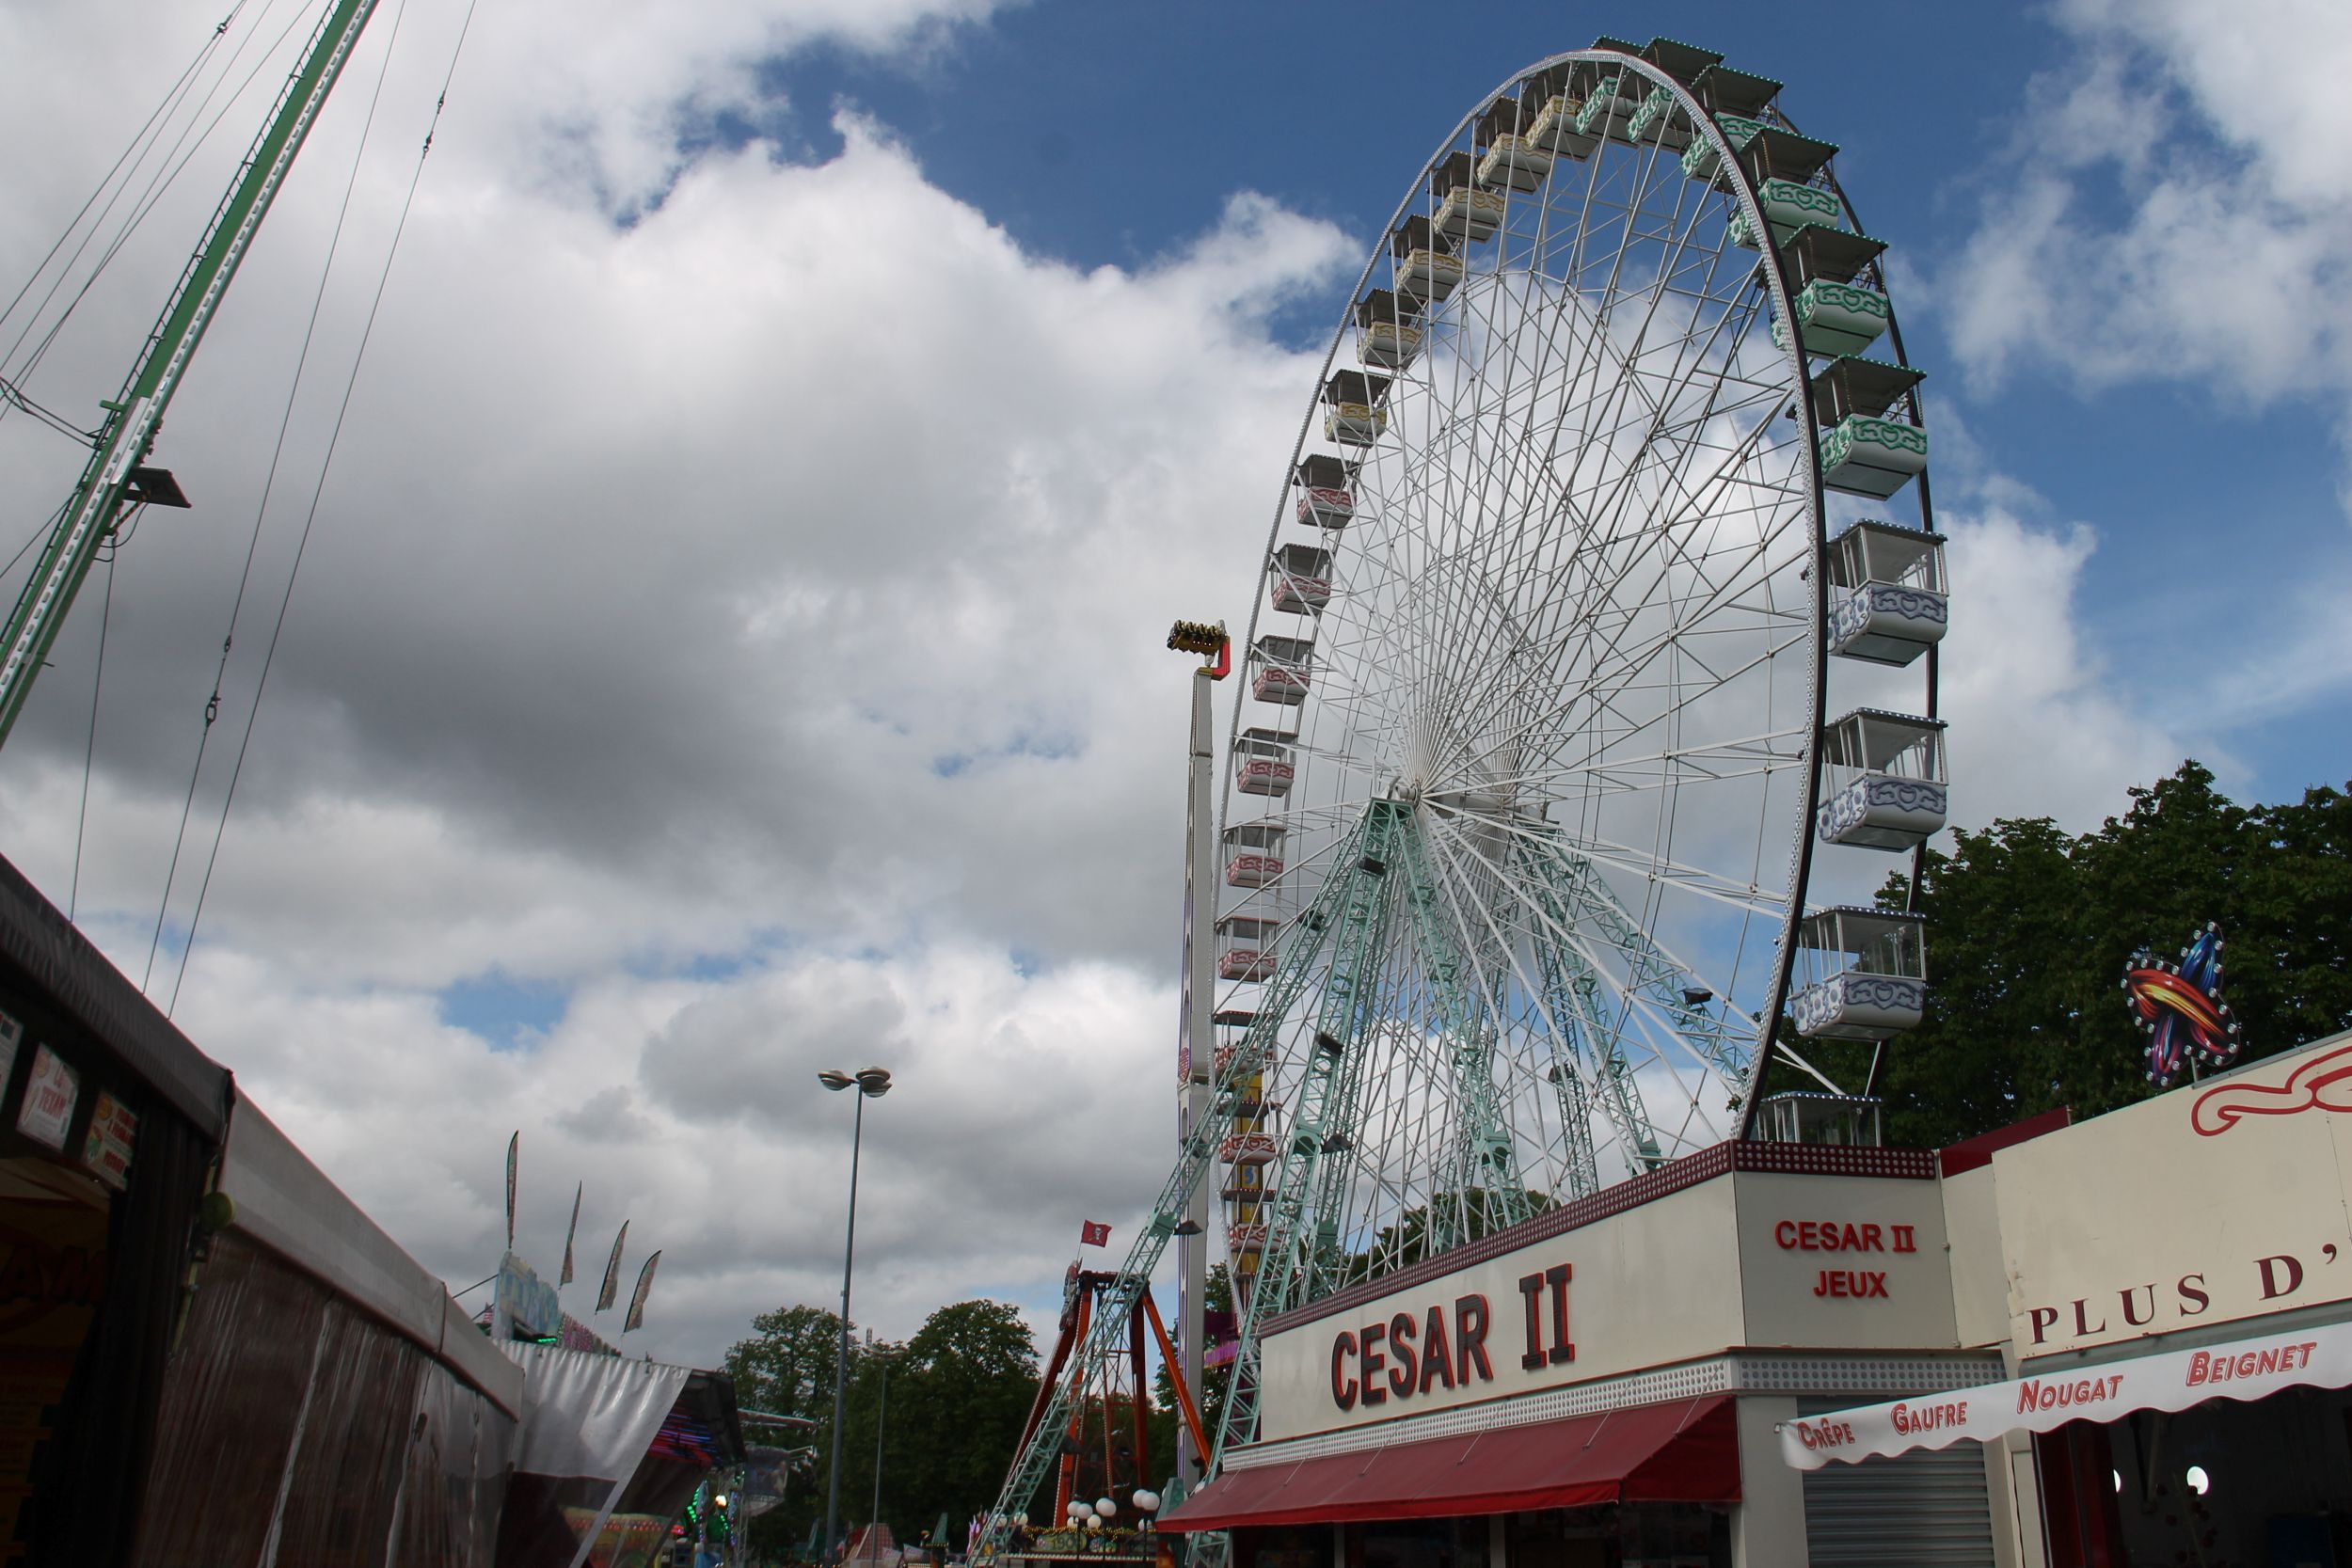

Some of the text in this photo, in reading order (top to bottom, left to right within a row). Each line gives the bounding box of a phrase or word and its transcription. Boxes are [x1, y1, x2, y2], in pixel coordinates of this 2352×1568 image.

[1775, 1220, 1916, 1252] CESAR II
[1813, 1271, 1889, 1298] JEUX
[2026, 1273, 2210, 1345] PLUS
[1331, 1263, 1575, 1411] CESAR II
[1797, 1341, 2317, 1450] CRÊPE GAUFRE NOUGAT BEIGNET
